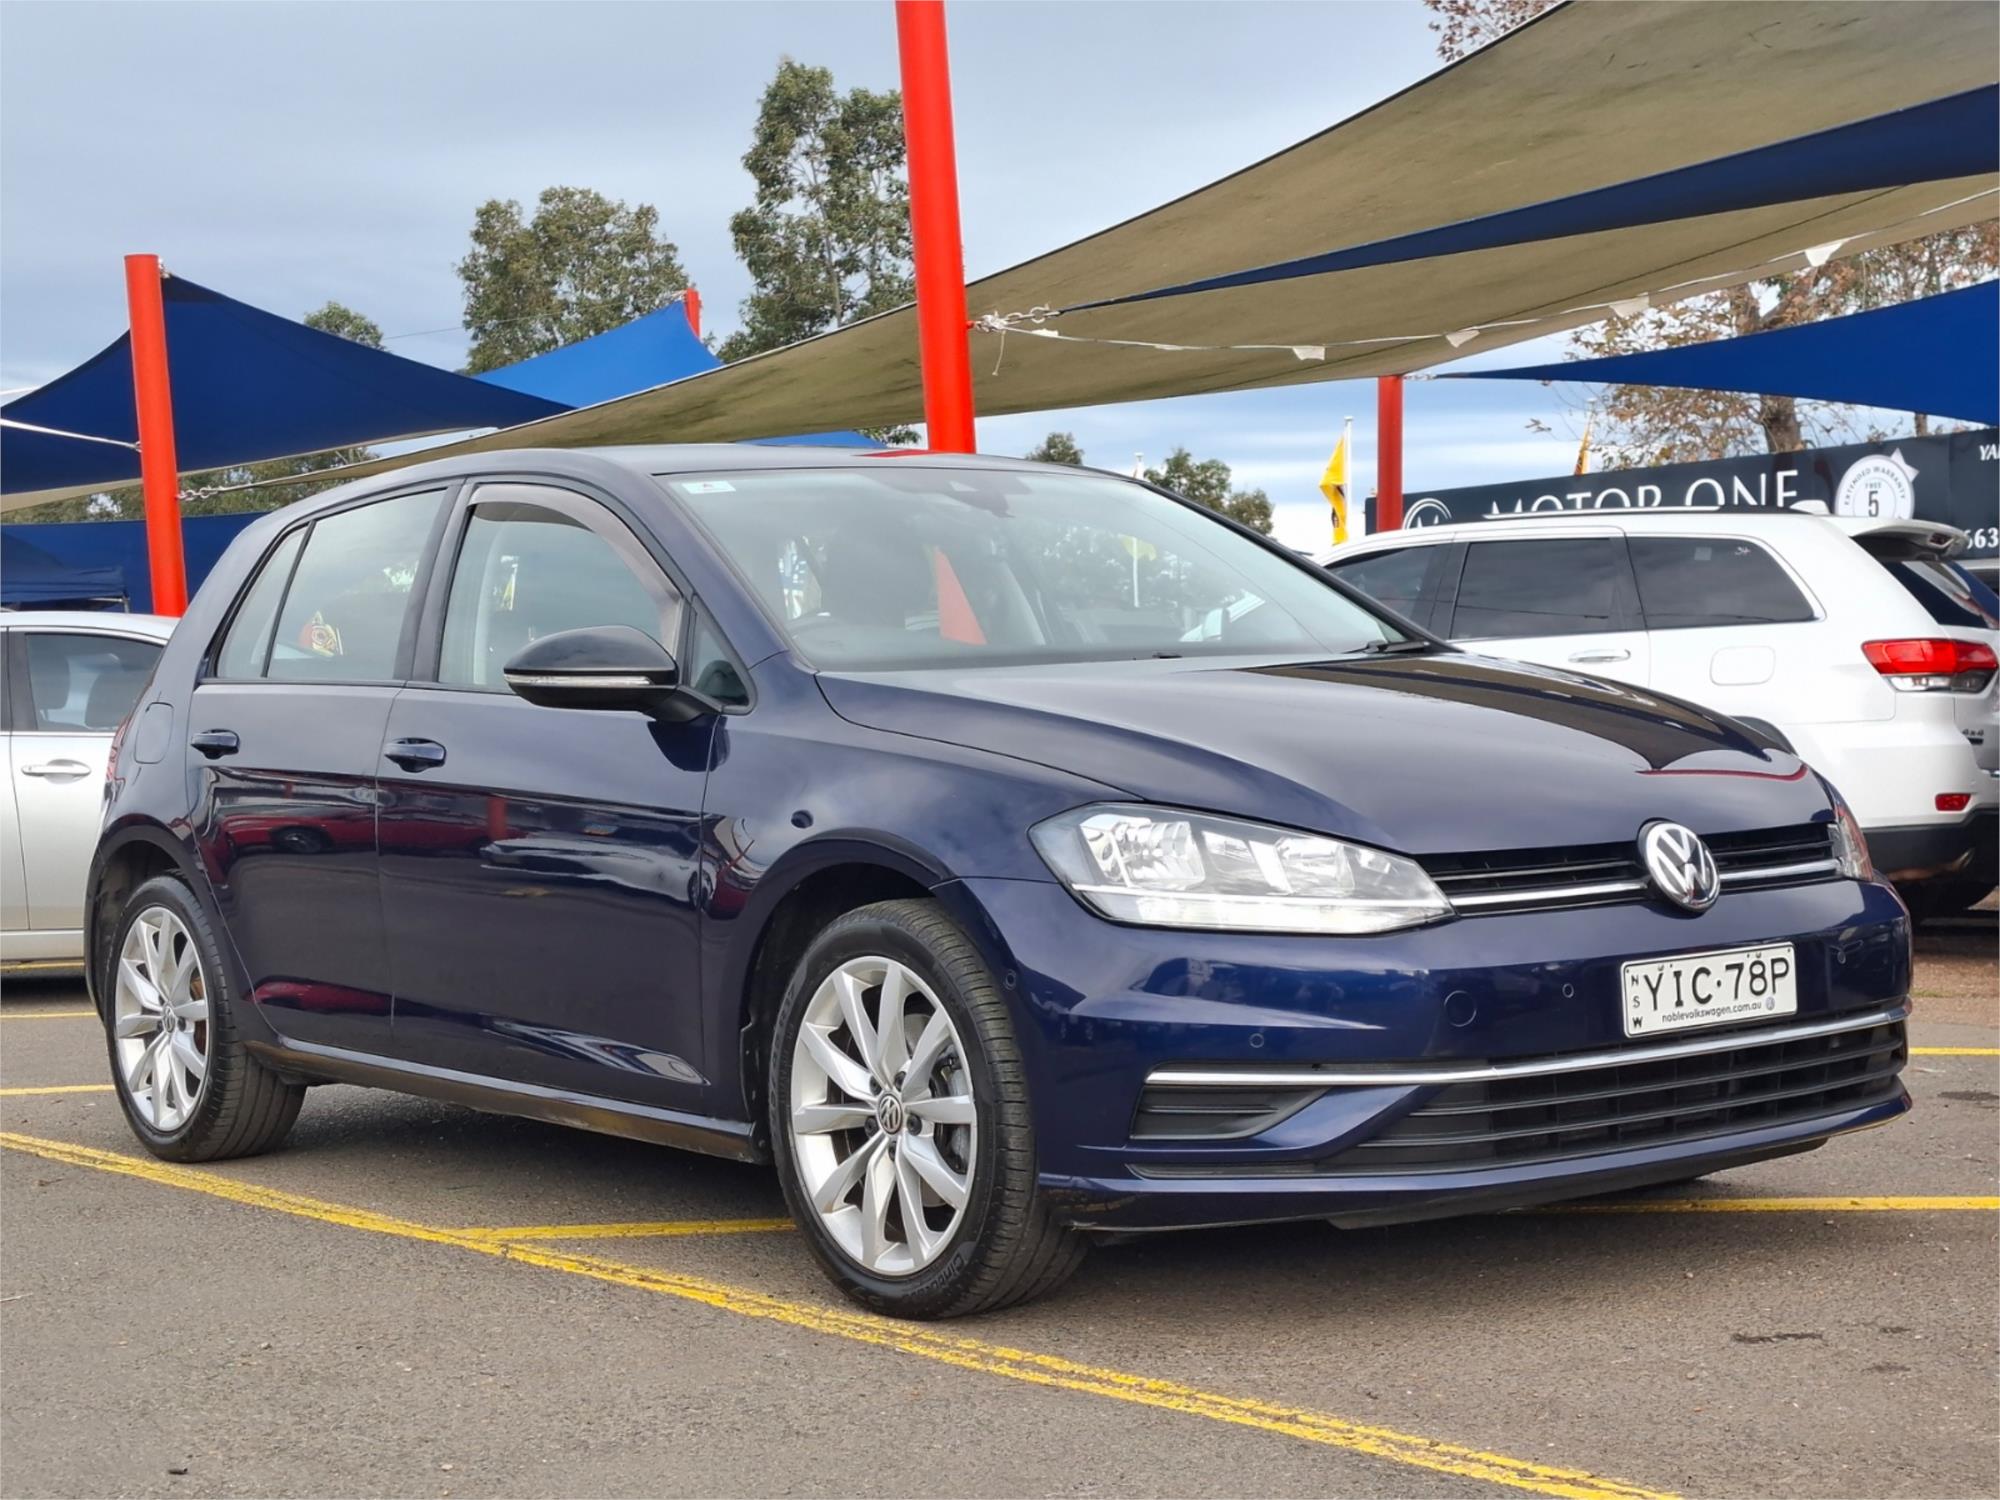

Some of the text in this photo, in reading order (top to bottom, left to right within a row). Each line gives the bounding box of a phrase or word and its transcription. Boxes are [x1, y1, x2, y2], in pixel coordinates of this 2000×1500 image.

[1979, 444, 1999, 461] YA
[1685, 469, 1798, 507] ONE
[1868, 490, 1879, 518] 5
[1661, 1001, 1762, 1023] noblevolkswagen.com.au
